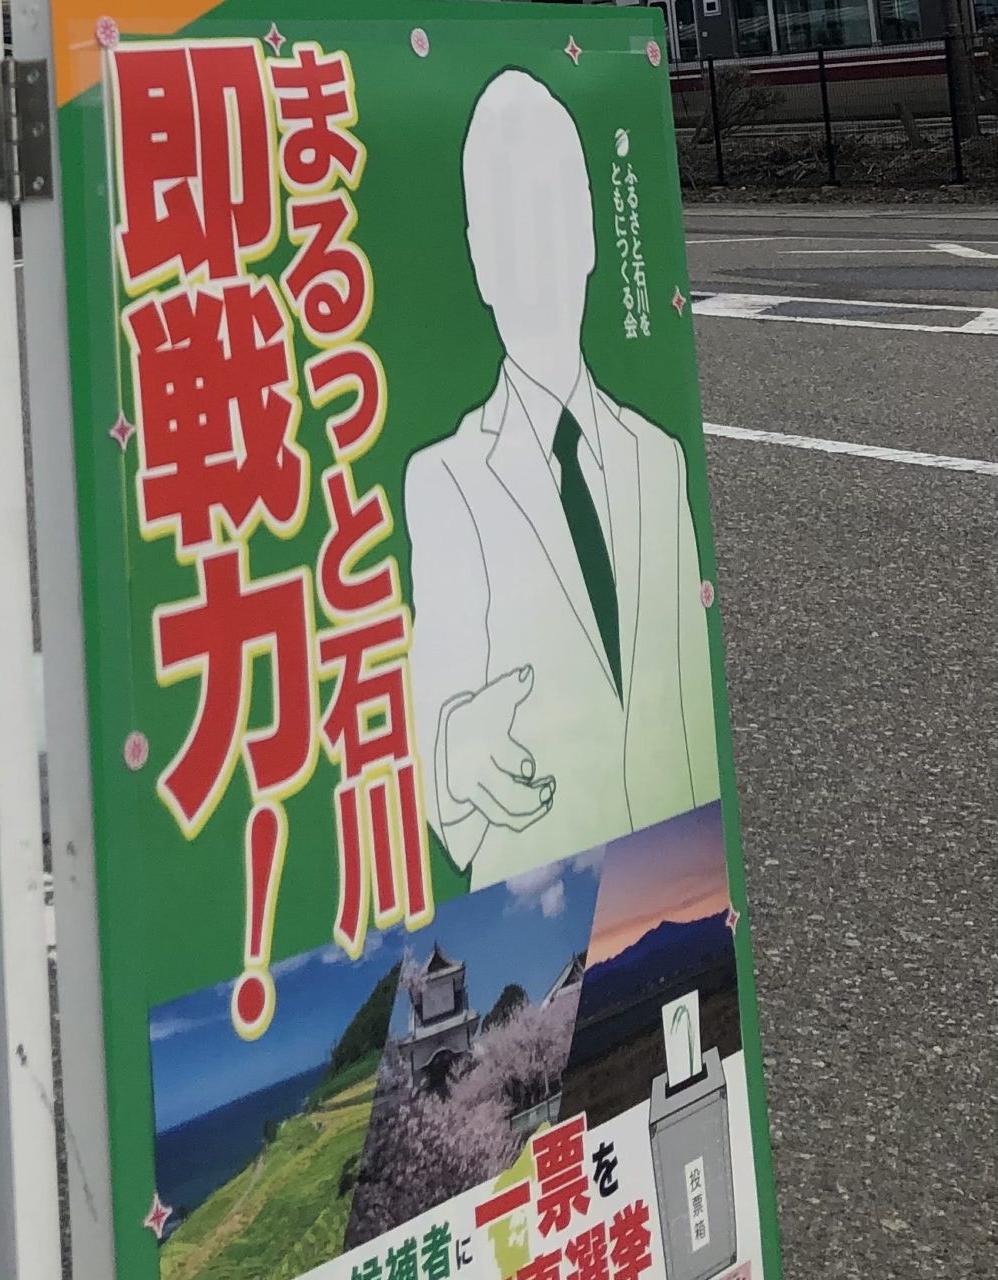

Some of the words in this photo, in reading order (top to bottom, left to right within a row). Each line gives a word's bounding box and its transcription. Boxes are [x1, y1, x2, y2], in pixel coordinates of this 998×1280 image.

[612, 162, 638, 339] ともにつくる会
[625, 163, 651, 337] ふるさと石川を
[109, 38, 315, 1038] 即戦力！
[265, 42, 433, 959] まるっと石川
[689, 1168, 707, 1241] 投票箱
